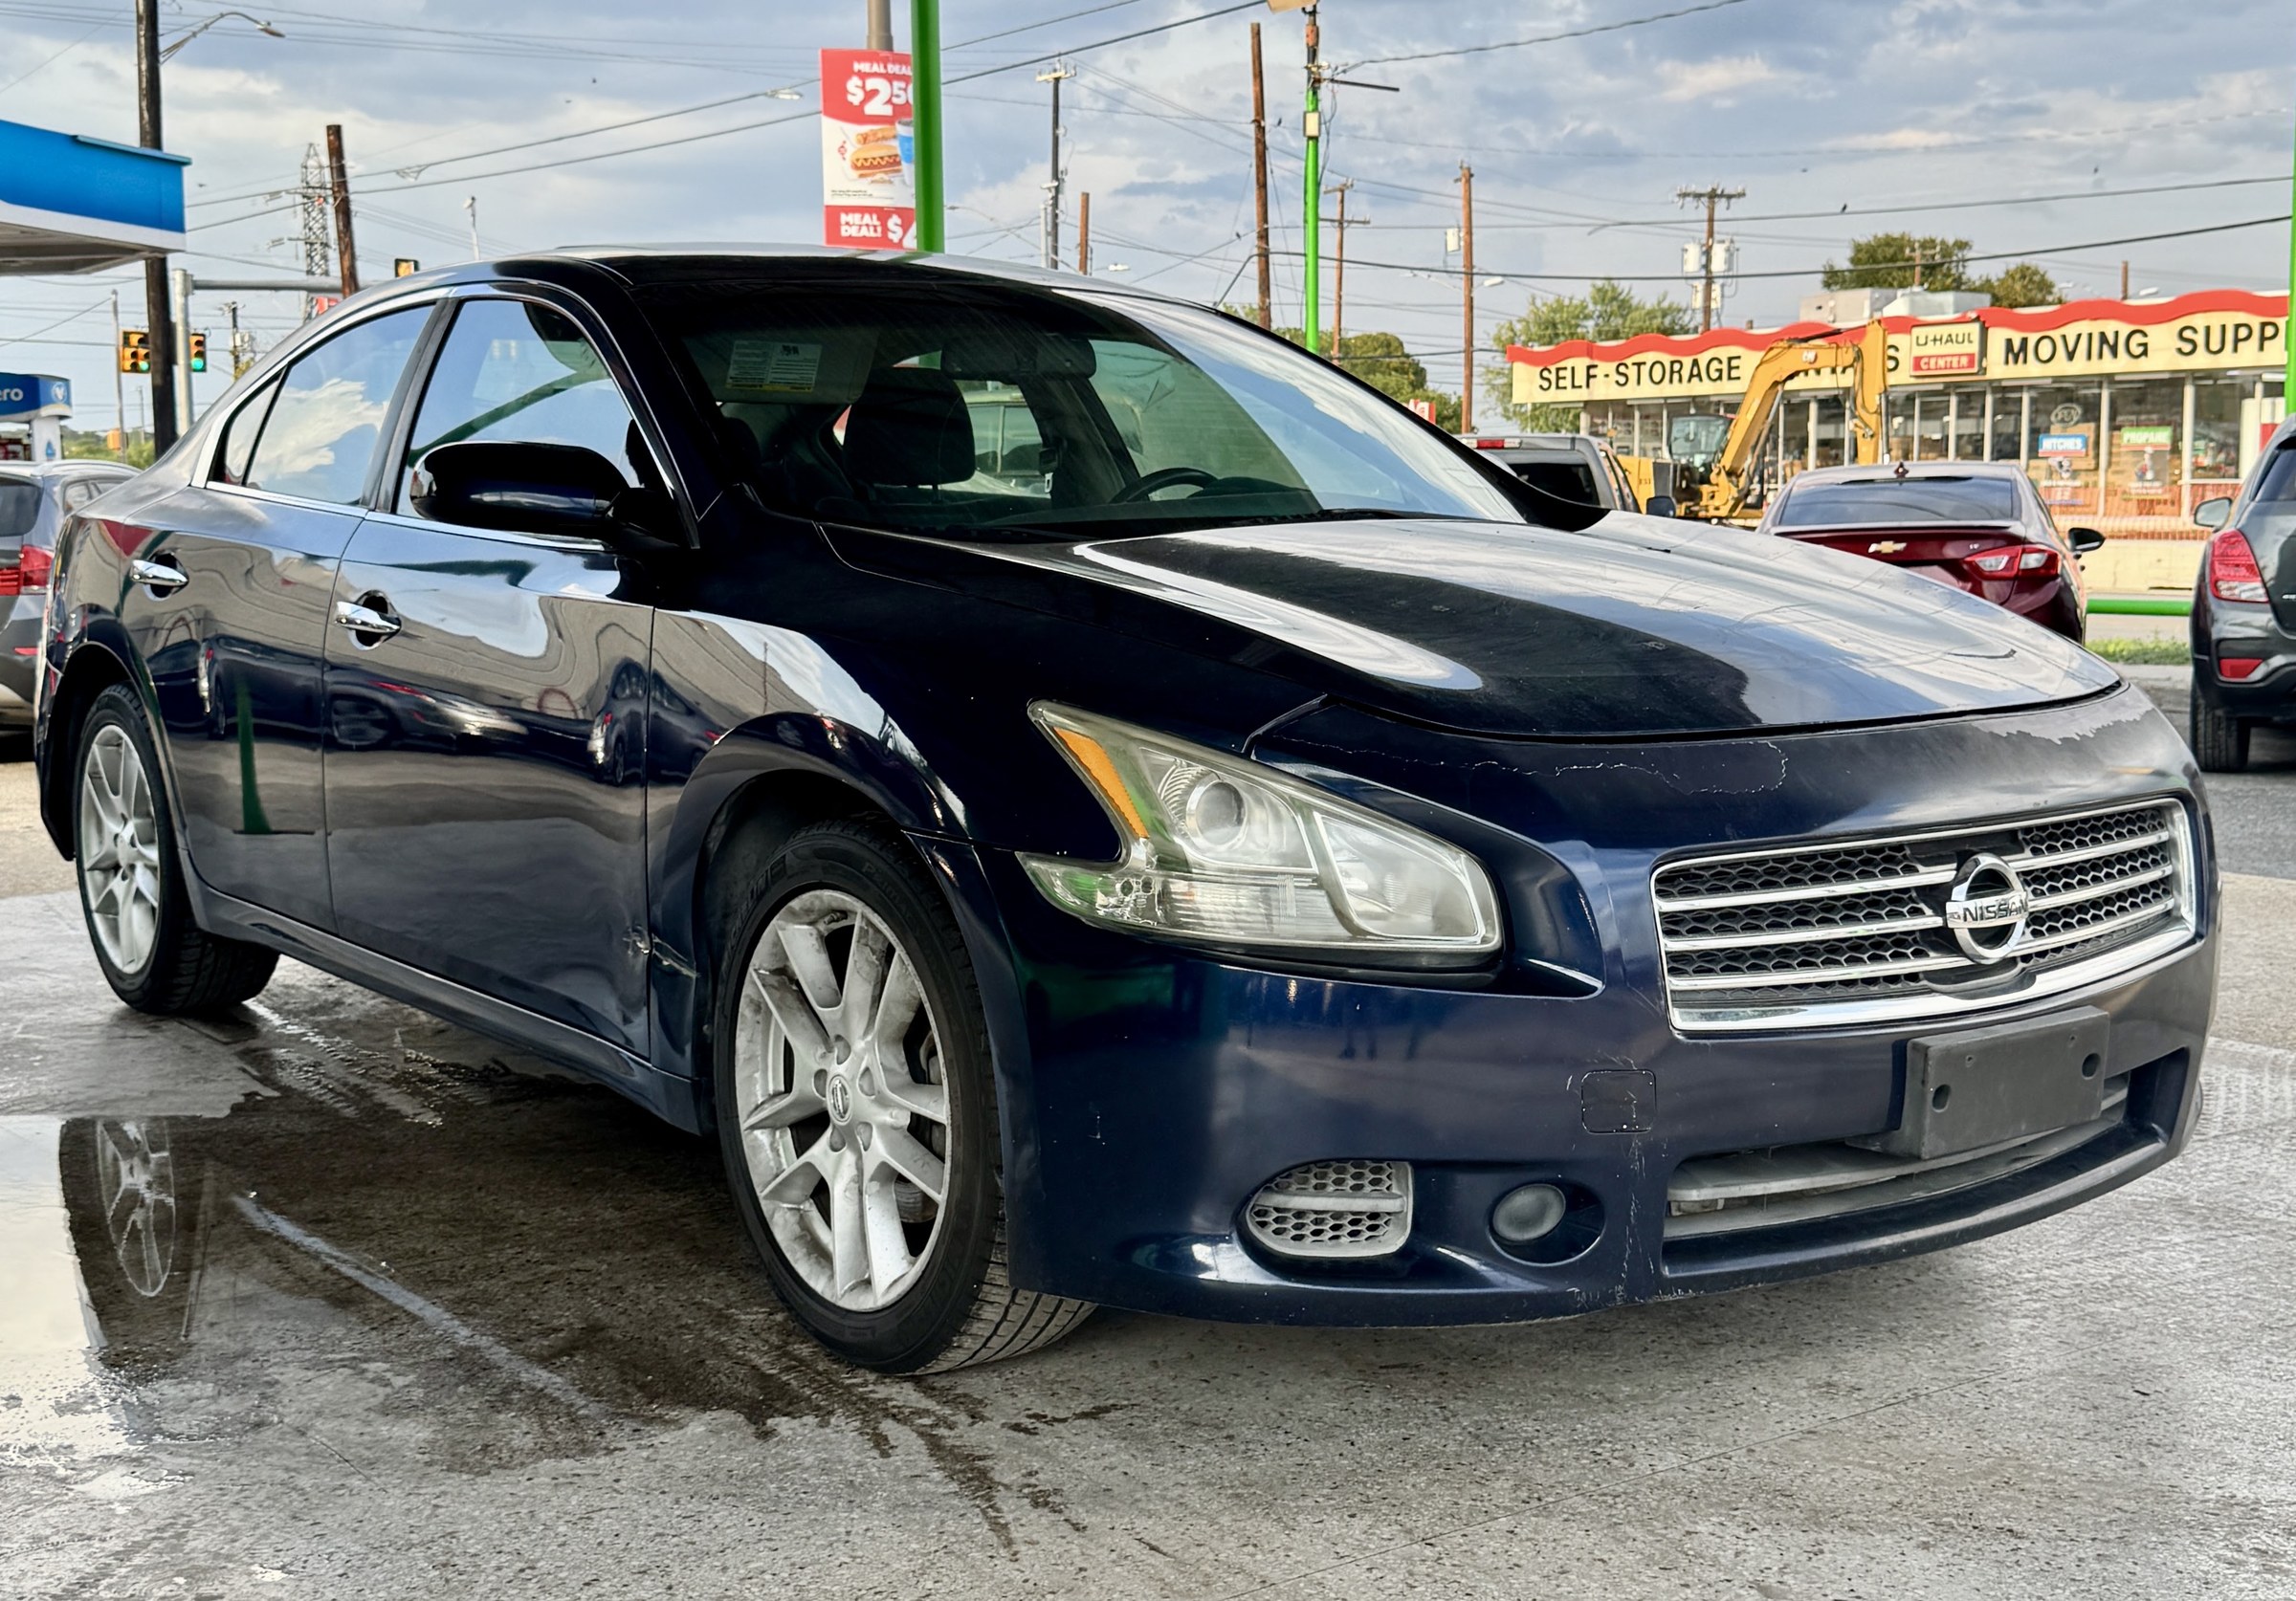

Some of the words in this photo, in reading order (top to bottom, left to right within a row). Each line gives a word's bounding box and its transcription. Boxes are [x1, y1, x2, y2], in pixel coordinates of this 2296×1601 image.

[853, 61, 886, 74] MEAL
[840, 212, 881, 225] MEAL
[840, 225, 882, 237] DEAL!
[1916, 332, 1974, 347] U-HAUL
[2002, 329, 2149, 365] MOVING
[2175, 321, 2287, 357] SUPP
[1920, 356, 1969, 371] CENTER
[1538, 355, 1741, 391] SELF-STORAGE
[0, 387, 24, 402] ro
[1962, 894, 2027, 922] NISSAN
